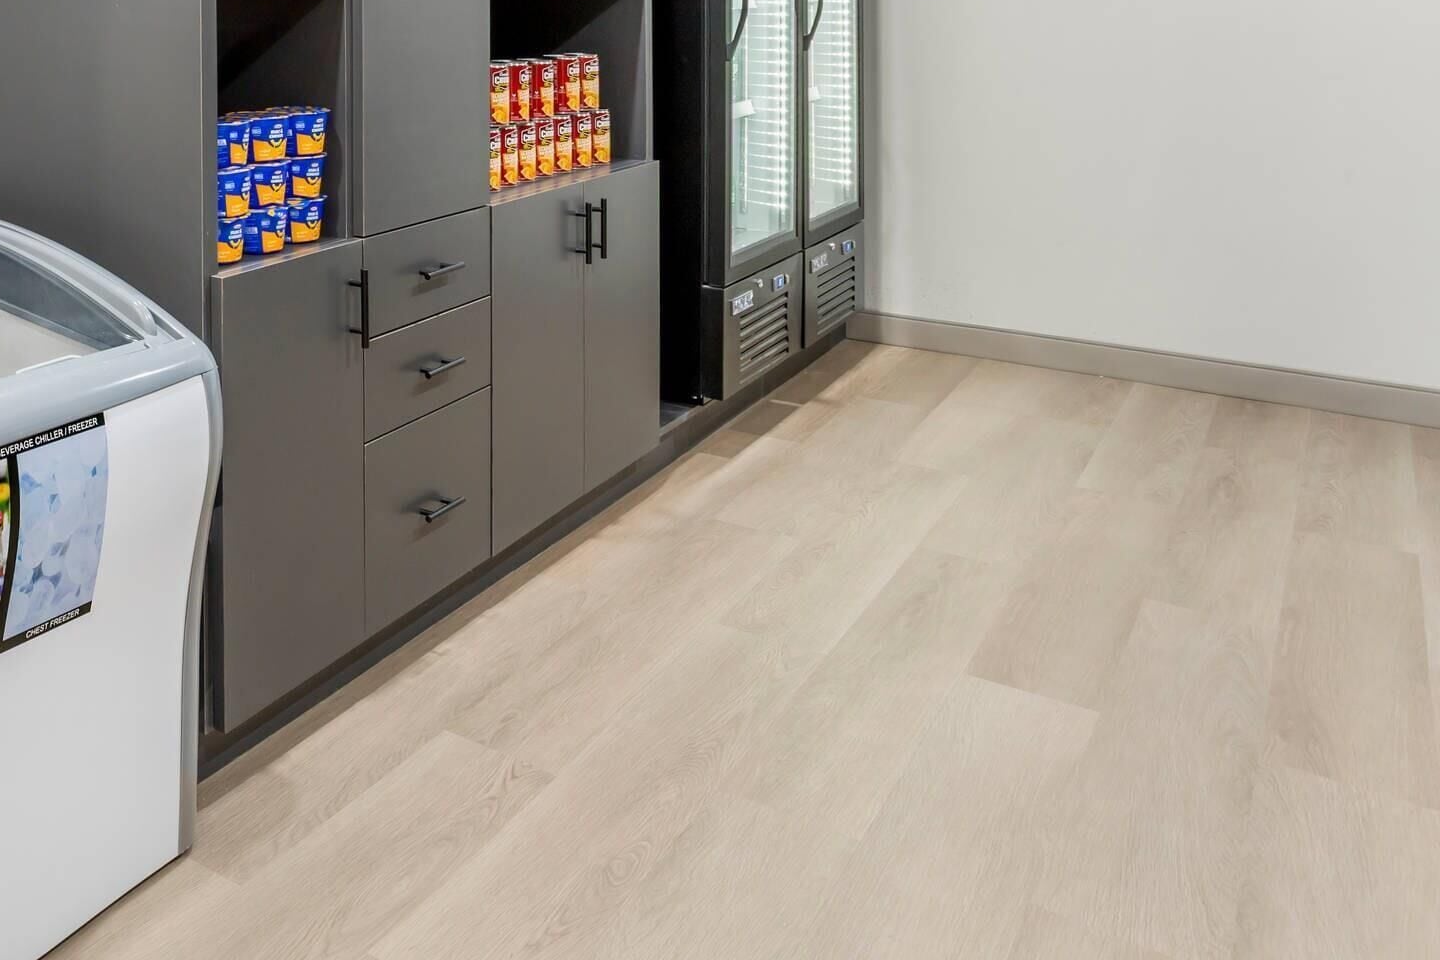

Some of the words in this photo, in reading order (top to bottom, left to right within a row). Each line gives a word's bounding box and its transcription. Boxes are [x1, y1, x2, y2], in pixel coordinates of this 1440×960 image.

[35, 430, 64, 445] CHILLER
[68, 417, 98, 434] FREEZER
[25, 623, 49, 639] CHEST
[50, 608, 80, 628] FREEZER
